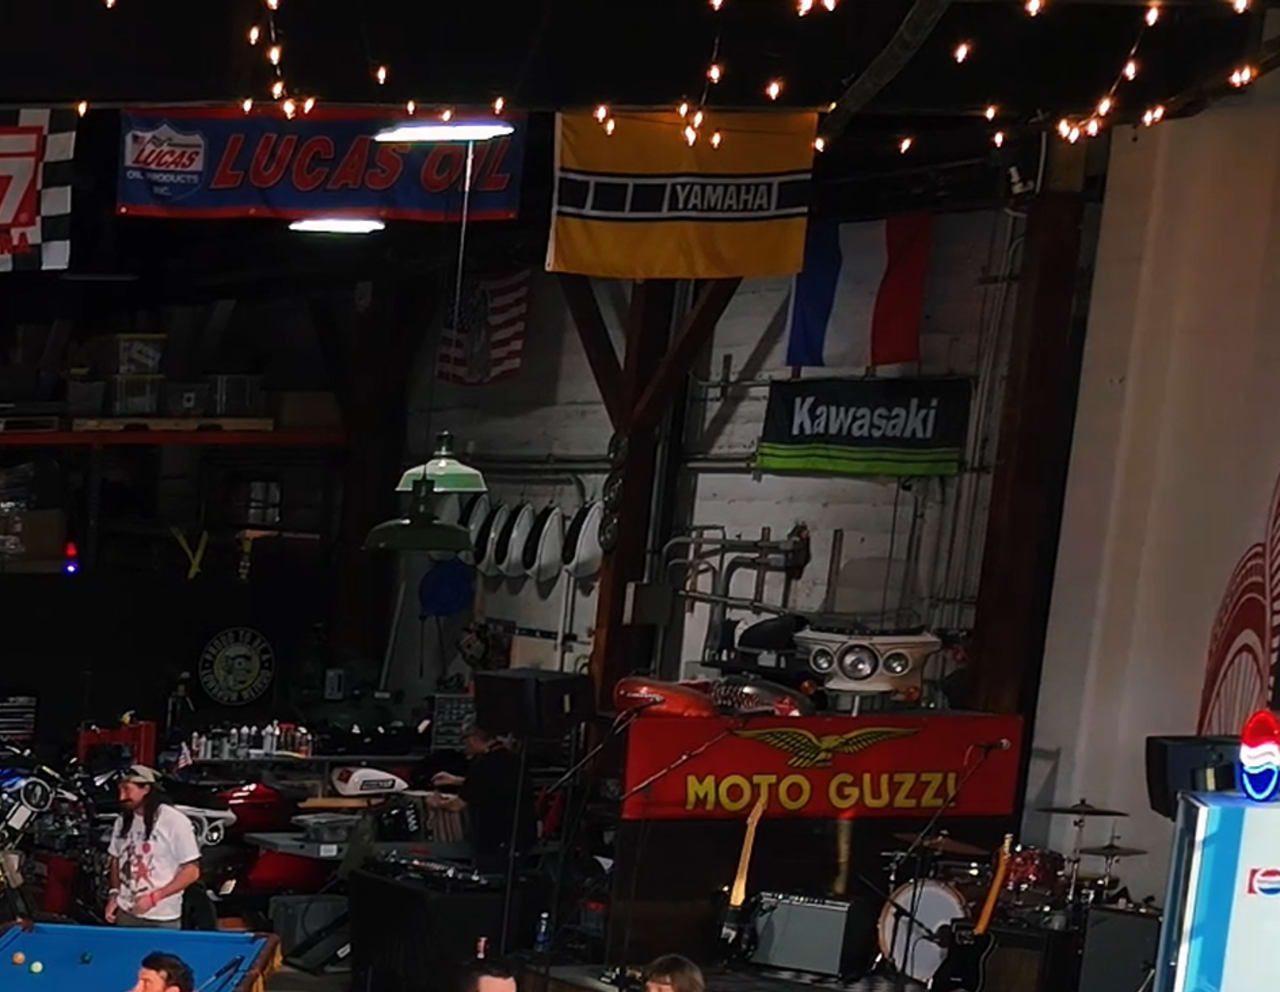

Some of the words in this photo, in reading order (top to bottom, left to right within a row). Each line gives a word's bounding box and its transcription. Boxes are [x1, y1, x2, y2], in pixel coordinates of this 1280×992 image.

[132, 148, 200, 169] LUCAS
[209, 134, 411, 192] LUCAS
[420, 137, 512, 192] OIL
[675, 184, 770, 210] YAMAHA
[791, 395, 940, 439] Kawasaki
[685, 773, 812, 812] MOTO
